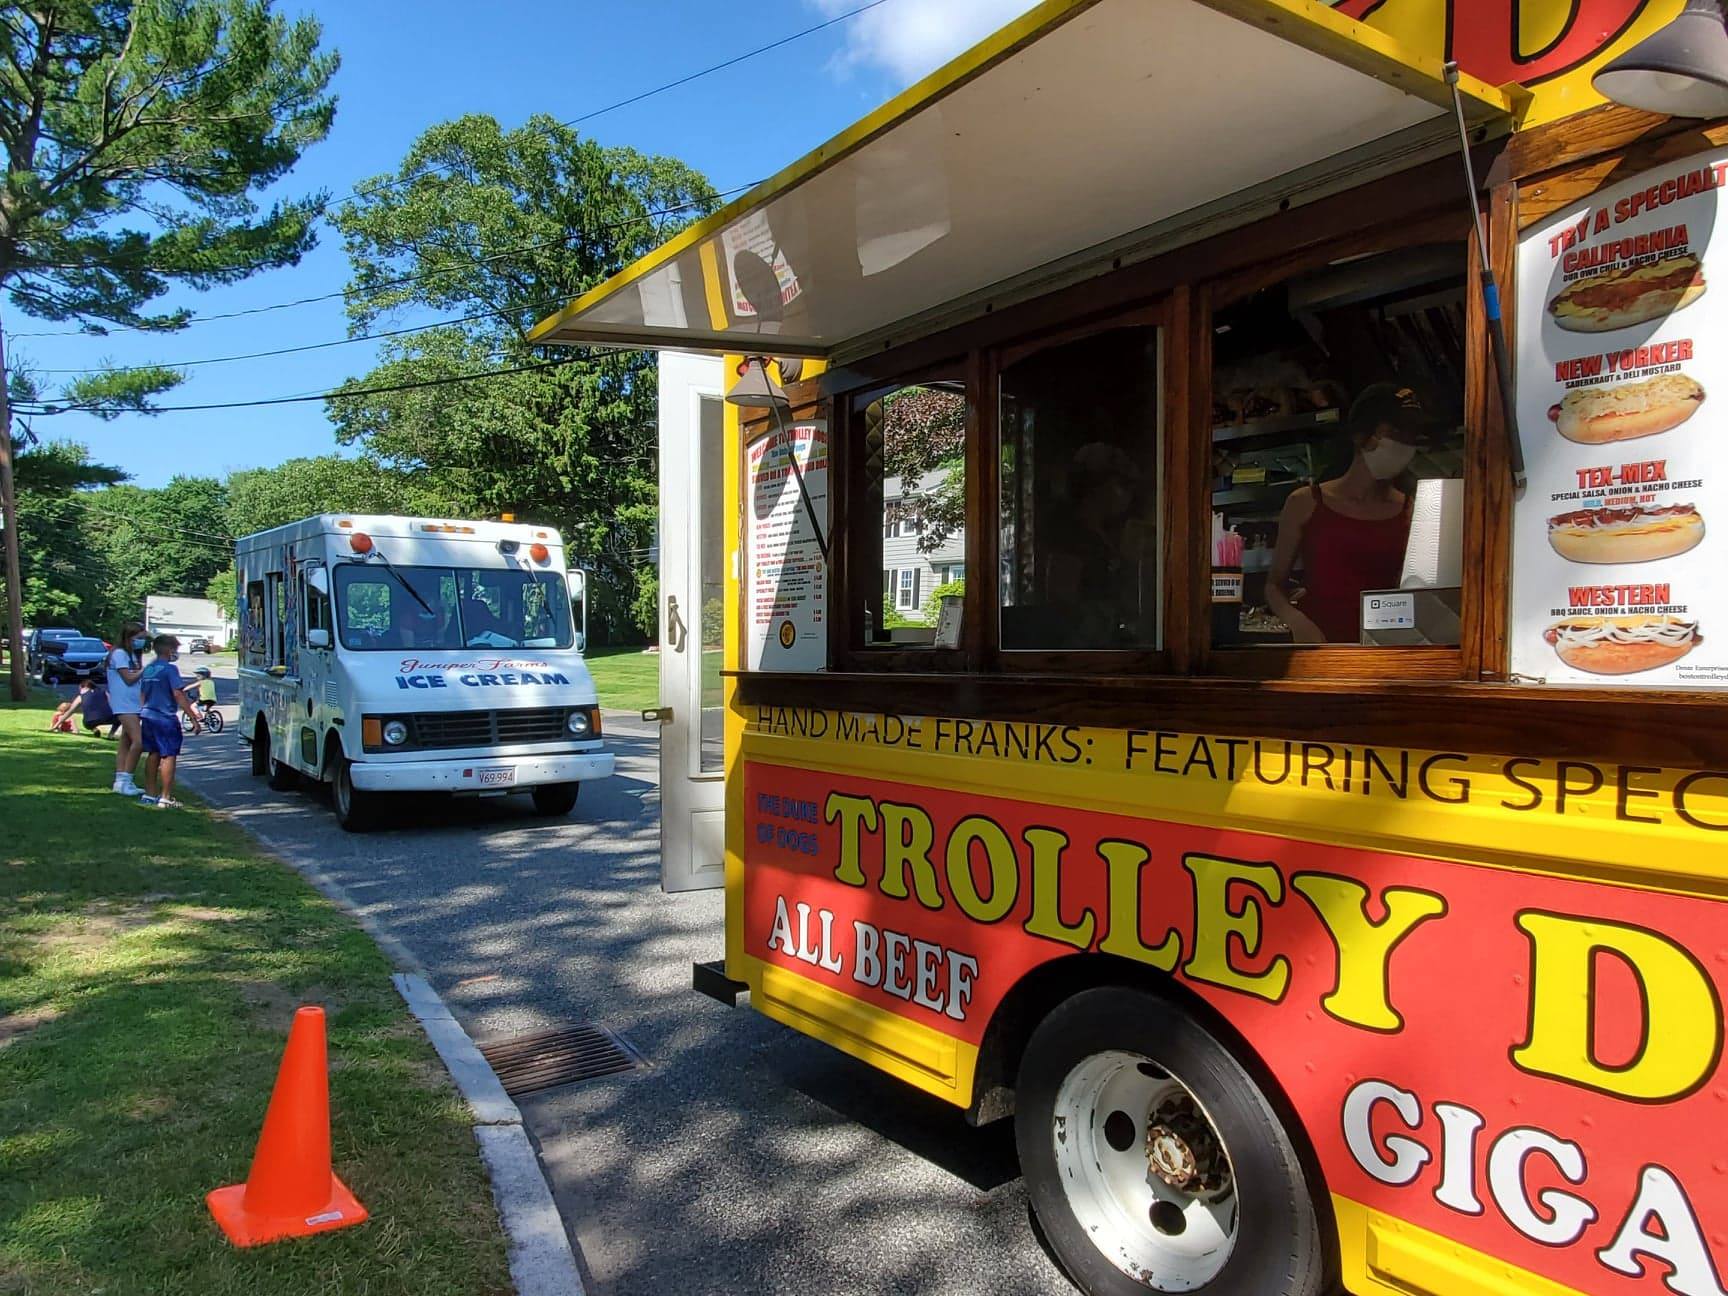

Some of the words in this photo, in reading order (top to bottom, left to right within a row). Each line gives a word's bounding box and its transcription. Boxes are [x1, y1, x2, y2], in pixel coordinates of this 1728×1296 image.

[1549, 216, 1591, 258] TRY
[1593, 207, 1610, 235] A
[1615, 164, 1728, 224] SPECIALT
[1563, 224, 1689, 273] CALIFORNIA
[1563, 272, 1578, 282] OUR
[1580, 268, 1598, 278] OWN
[1600, 263, 1620, 274] CHILI
[1621, 261, 1627, 269] &
[1629, 253, 1656, 266] NACHO
[1658, 246, 1688, 260] CHEESE
[1555, 353, 1603, 382] NEW
[1606, 338, 1694, 373] YORKER
[1565, 374, 1614, 389] SAUERKRAUT
[1623, 370, 1640, 380] DELI
[1642, 363, 1681, 377] MUSTARD
[1551, 492, 1580, 502] SPECIAL
[1608, 486, 1633, 496] ONION
[1642, 482, 1670, 492] NACHO
[1671, 478, 1703, 489] CHEESE
[1576, 459, 1667, 490] TEX-MEX
[1640, 494, 1657, 503] HOT
[1568, 583, 1671, 607] WESTERN
[1550, 607, 1566, 617] BBQ
[1594, 606, 1619, 615] ONION
[1628, 605, 1655, 614] NACHO
[1656, 605, 1688, 614] CHEESE
[395, 675, 447, 690] ICE
[460, 672, 570, 688] CREAM
[757, 705, 828, 738] HAND
[836, 711, 922, 748] MADE
[935, 718, 1094, 765] FRANKS:
[1124, 730, 1472, 804] FEATURING
[757, 792, 781, 816] THE
[777, 827, 818, 857] DOGS
[767, 894, 843, 976] ALL
[853, 919, 980, 1022] BEEF
[825, 791, 1449, 1035] TROLLEY
[1508, 908, 1725, 1105] D
[1341, 1078, 1728, 1296] GIGA
